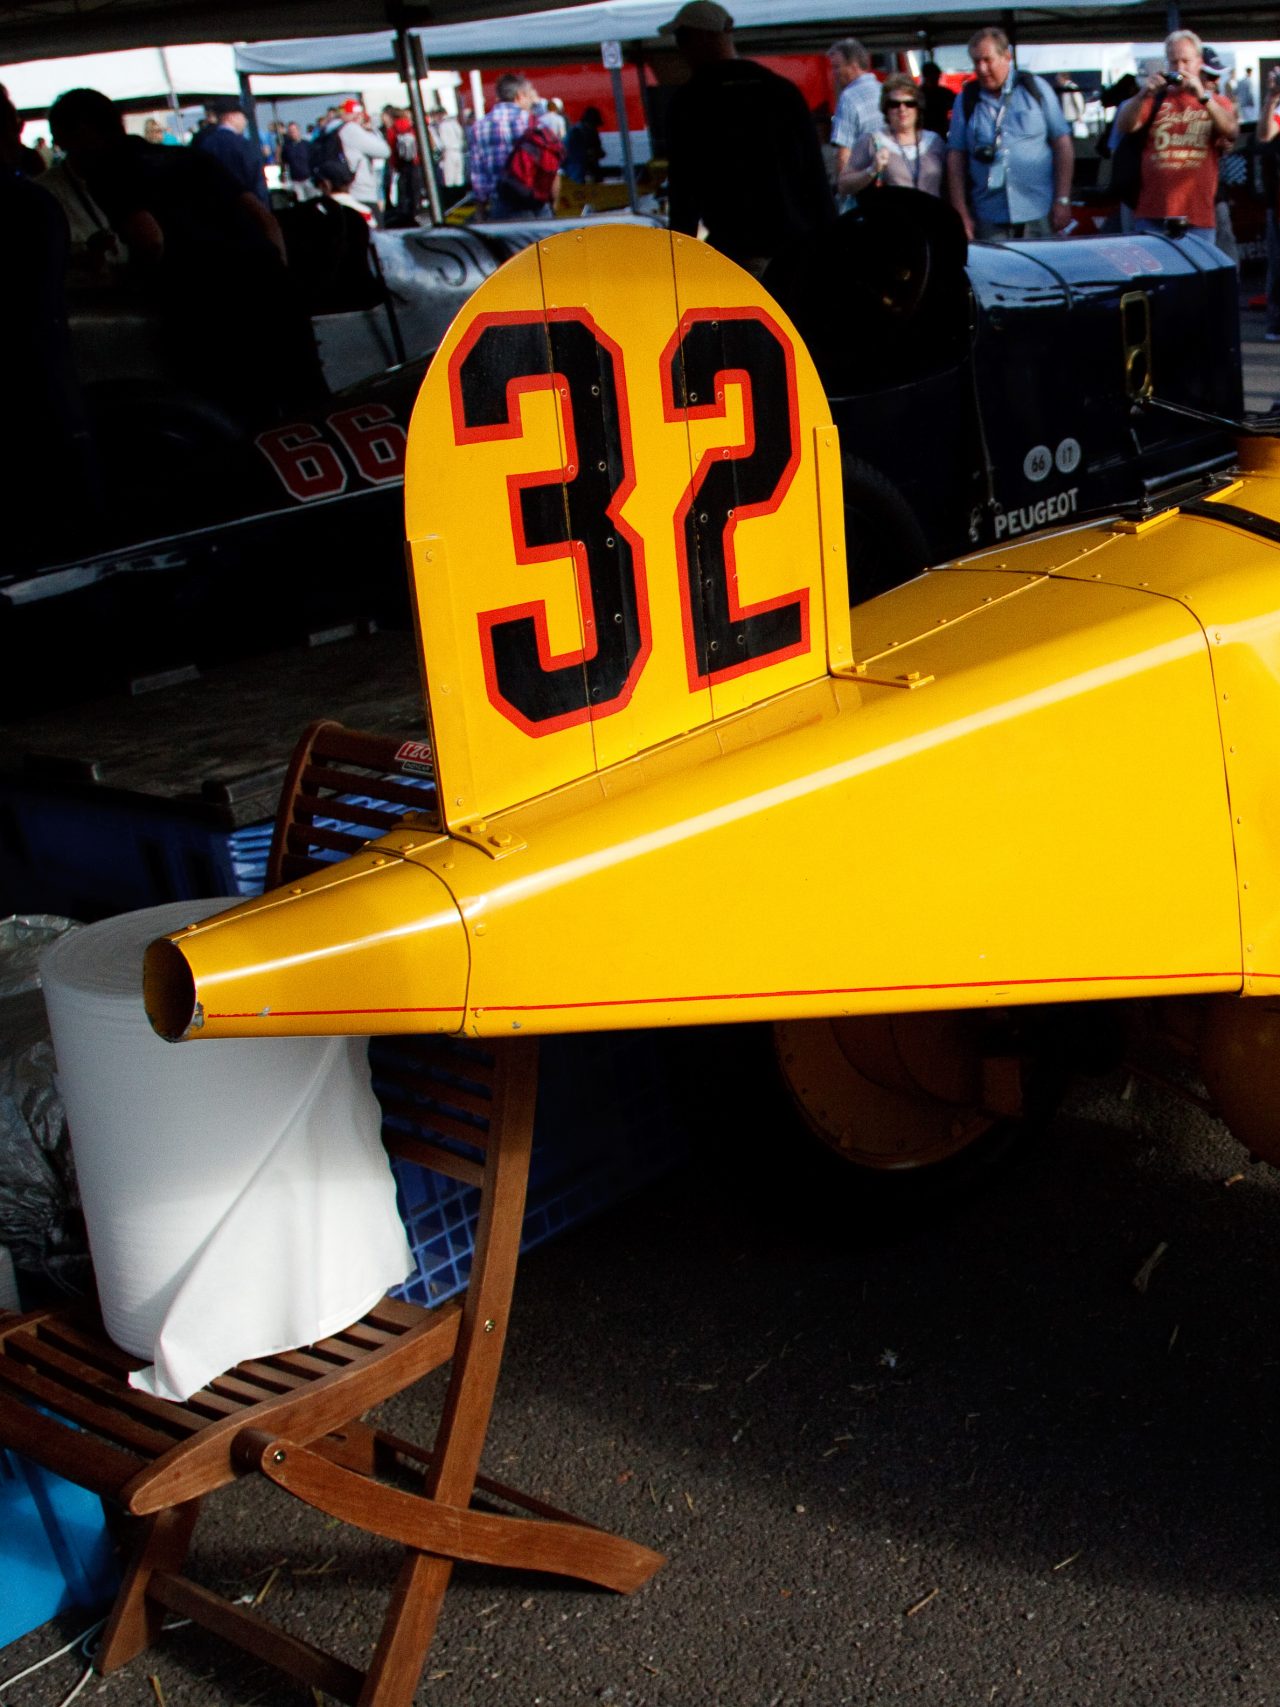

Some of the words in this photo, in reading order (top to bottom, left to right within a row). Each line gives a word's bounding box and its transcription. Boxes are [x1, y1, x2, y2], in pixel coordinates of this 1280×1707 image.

[254, 402, 407, 502] 66
[1032, 455, 1046, 473] 66
[448, 306, 810, 738] 32
[994, 487, 1080, 540] PEUGEOT
[400, 743, 433, 760] IZO
